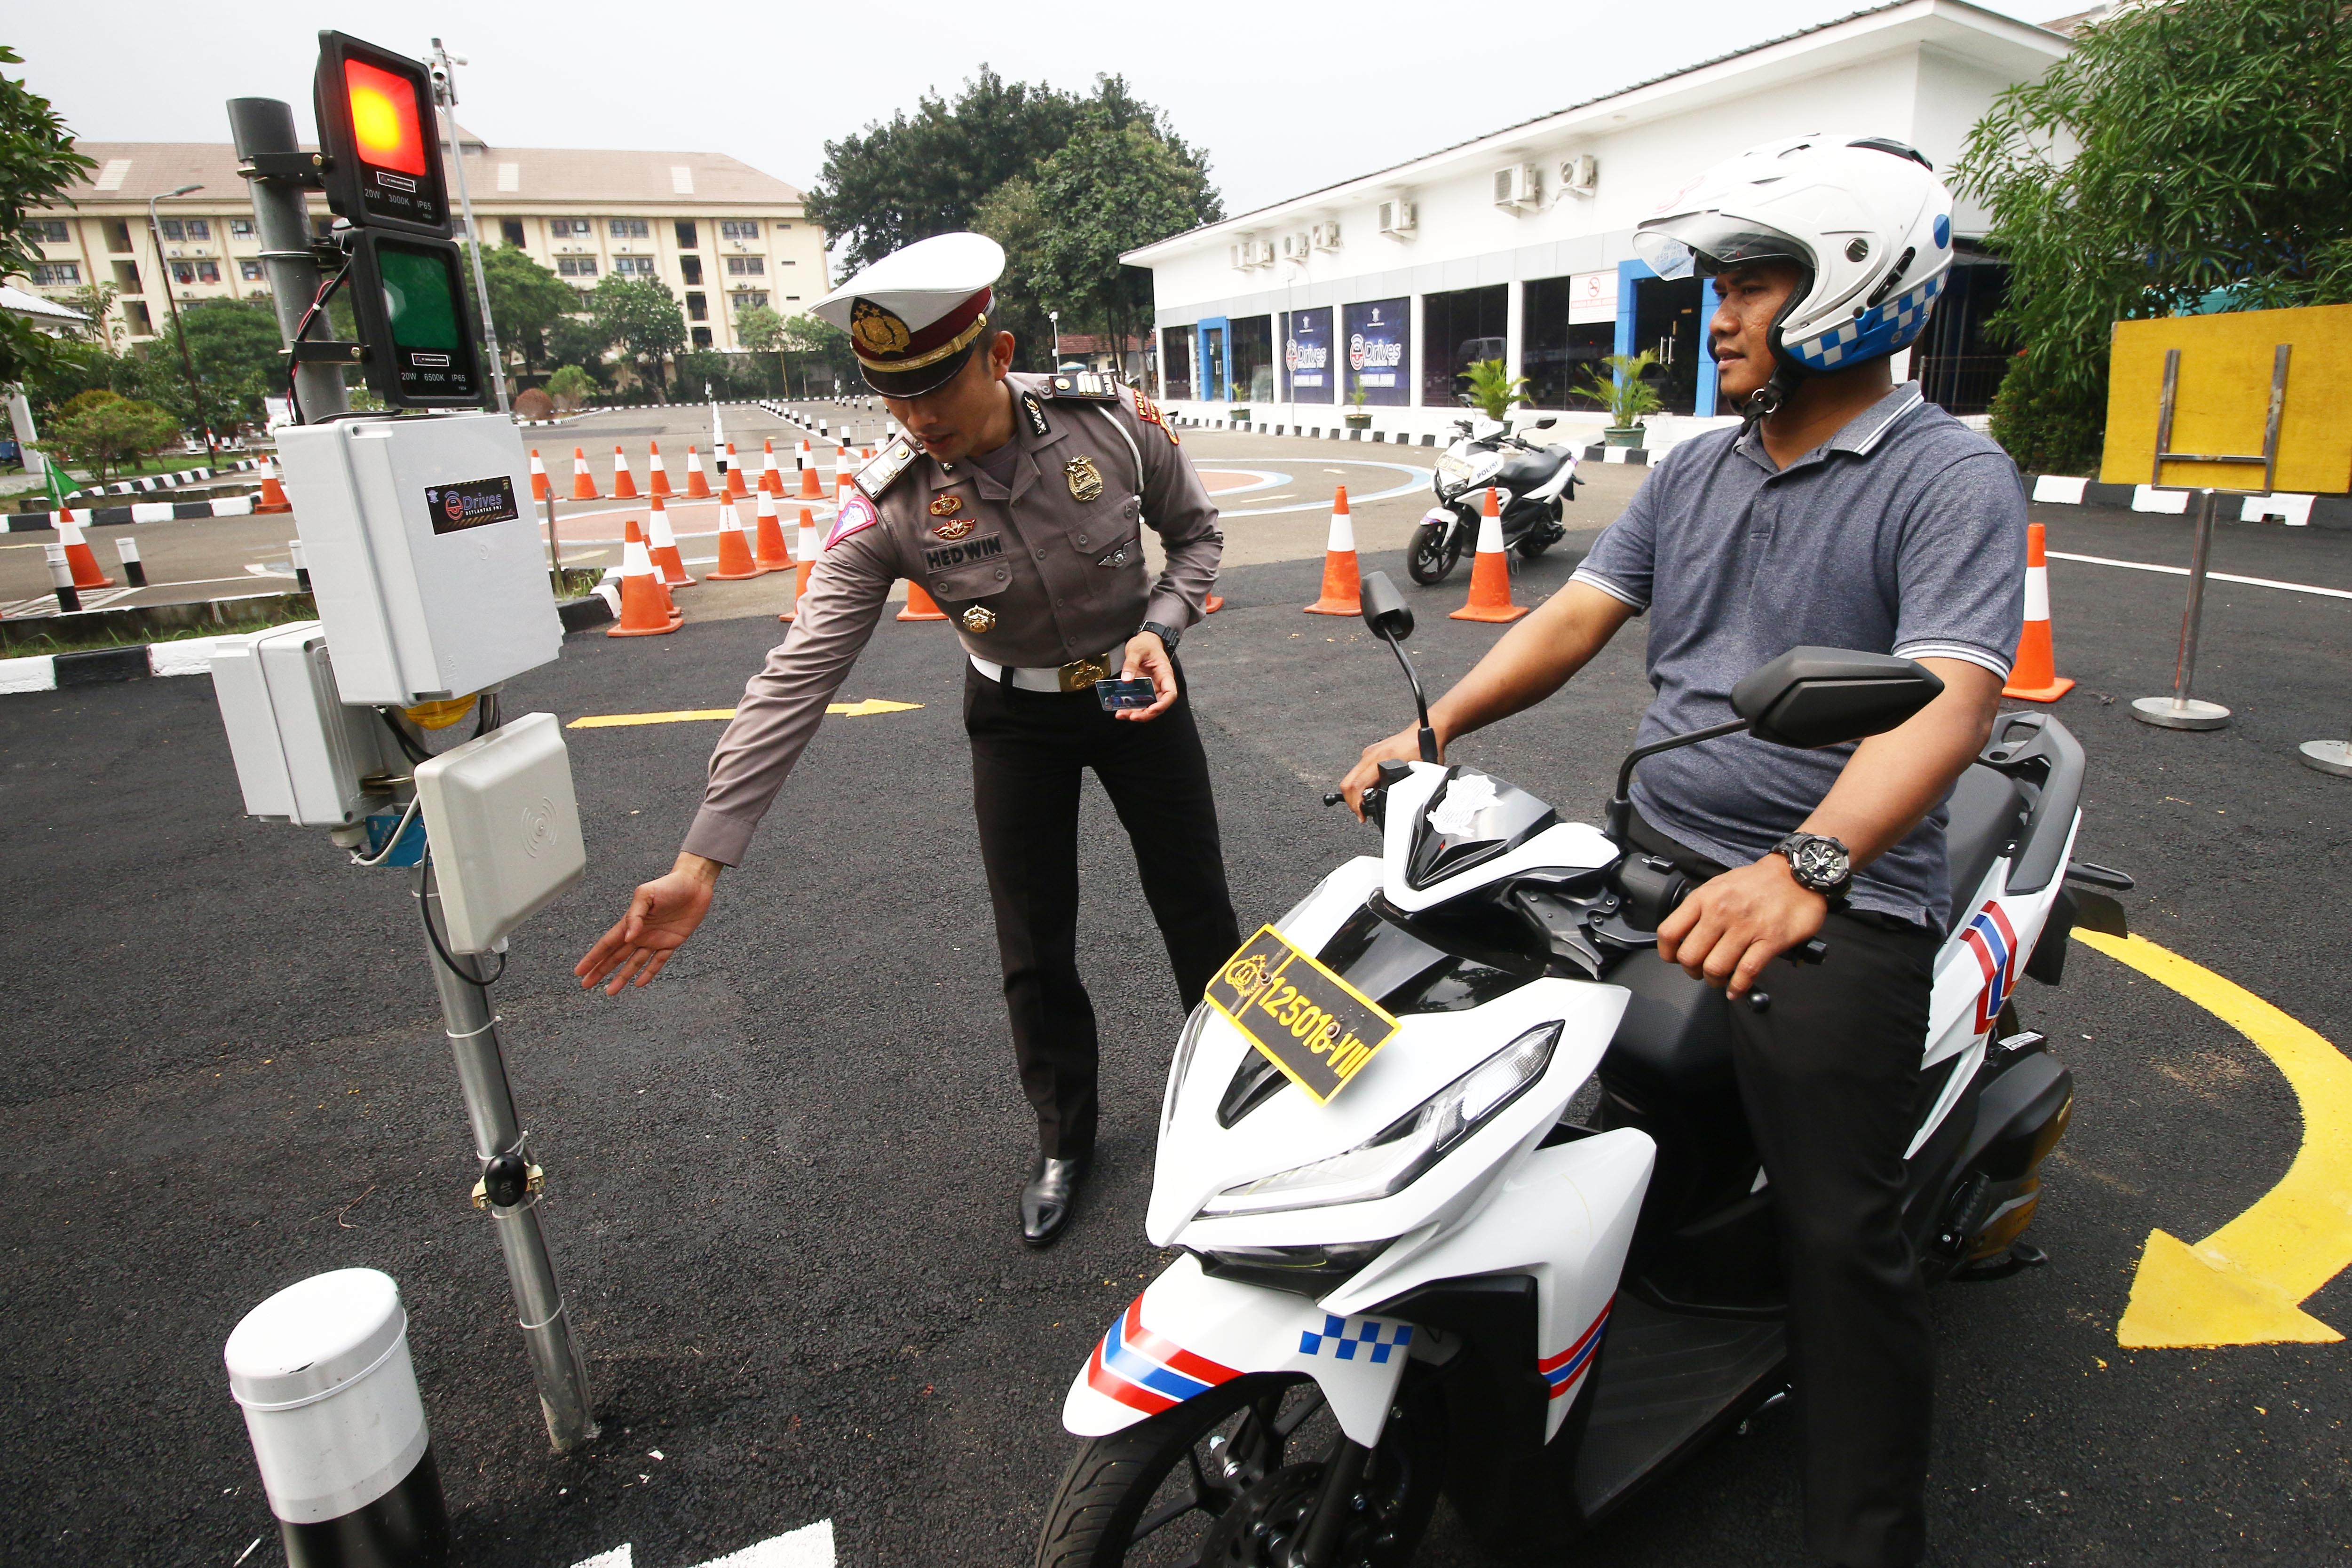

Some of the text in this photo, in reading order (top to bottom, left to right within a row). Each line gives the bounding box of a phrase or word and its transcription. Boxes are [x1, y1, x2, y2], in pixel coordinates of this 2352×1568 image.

[364, 189, 431, 210] 20W 3000K IP65
[1477, 461, 1498, 479] POLISI
[465, 507, 492, 516] DITLANTAS
[926, 535, 1002, 569] HEDWIN
